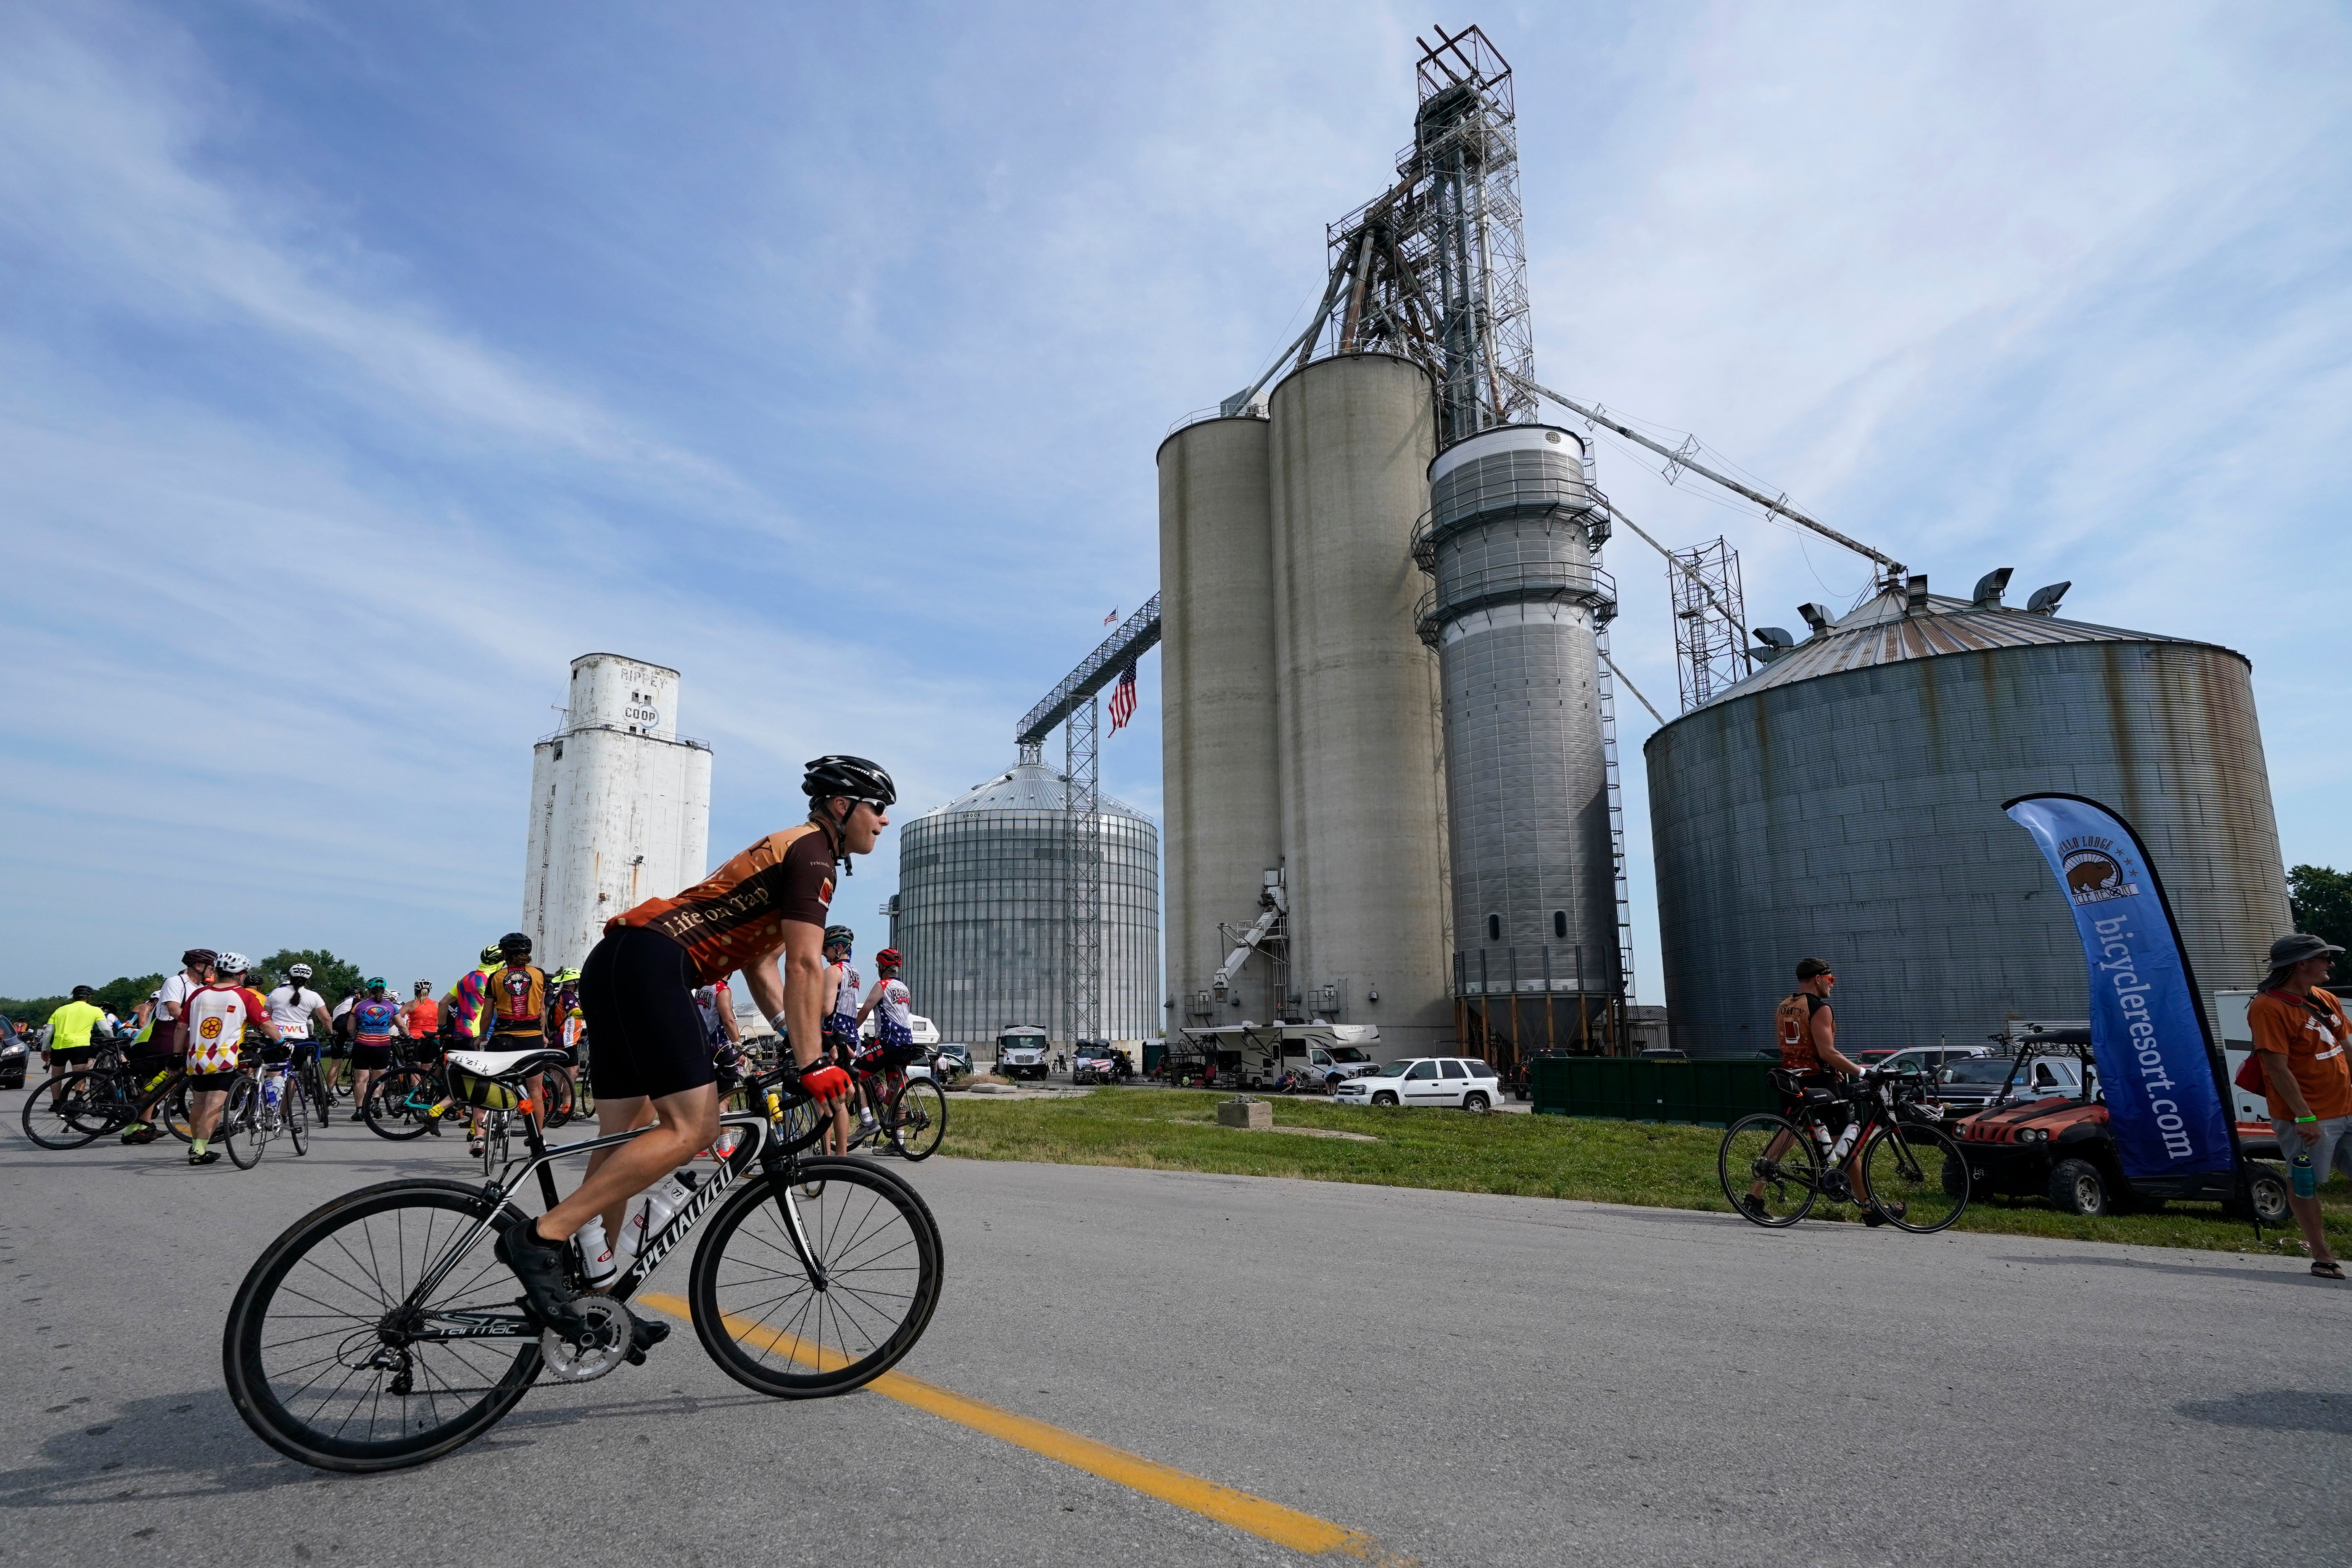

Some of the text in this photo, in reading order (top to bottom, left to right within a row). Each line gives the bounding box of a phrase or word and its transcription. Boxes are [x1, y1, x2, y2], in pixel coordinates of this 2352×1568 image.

[621, 668, 667, 689] RIPPEY
[625, 707, 655, 722] COOP
[851, 766, 870, 775] GIRO
[2083, 836, 2114, 850] LODGE
[662, 911, 704, 937] Life
[729, 887, 771, 912] Tap
[2095, 915, 2193, 1159] bicycleresort.com
[633, 1161, 733, 1287] SPECIALIZED
[634, 1216, 644, 1227] ERIK
